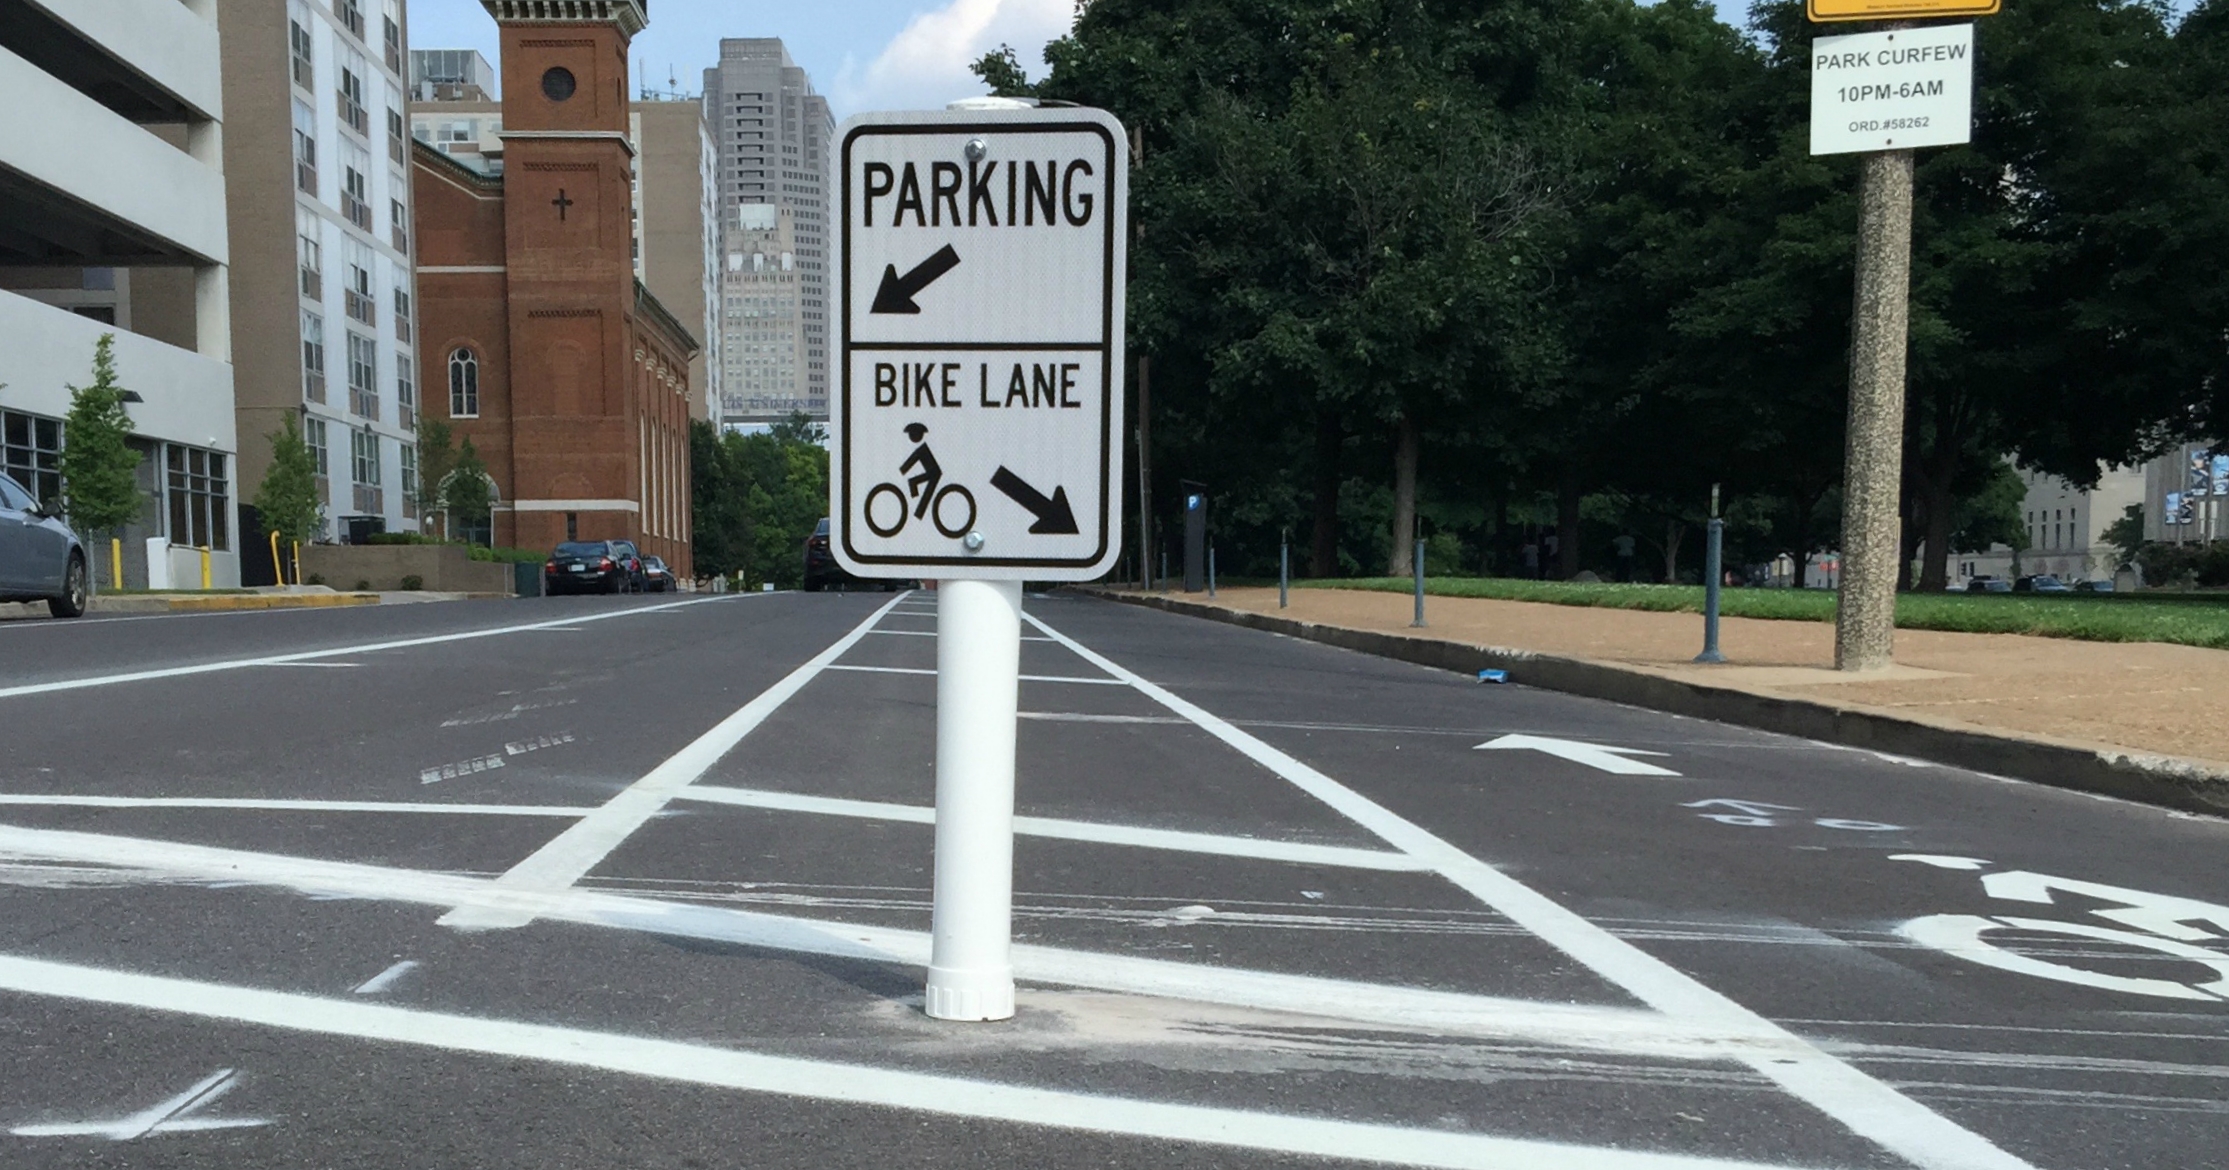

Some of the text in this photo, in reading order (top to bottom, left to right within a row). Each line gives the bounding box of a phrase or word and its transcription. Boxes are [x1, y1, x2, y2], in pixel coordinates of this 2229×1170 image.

[1816, 44, 1967, 70] PARK CURFEW
[1838, 80, 1943, 103] 10PM-6AM
[1848, 117, 1930, 132] ORD.#58262
[864, 158, 1093, 226] PARKING
[875, 362, 1081, 408] BIKE LANE
